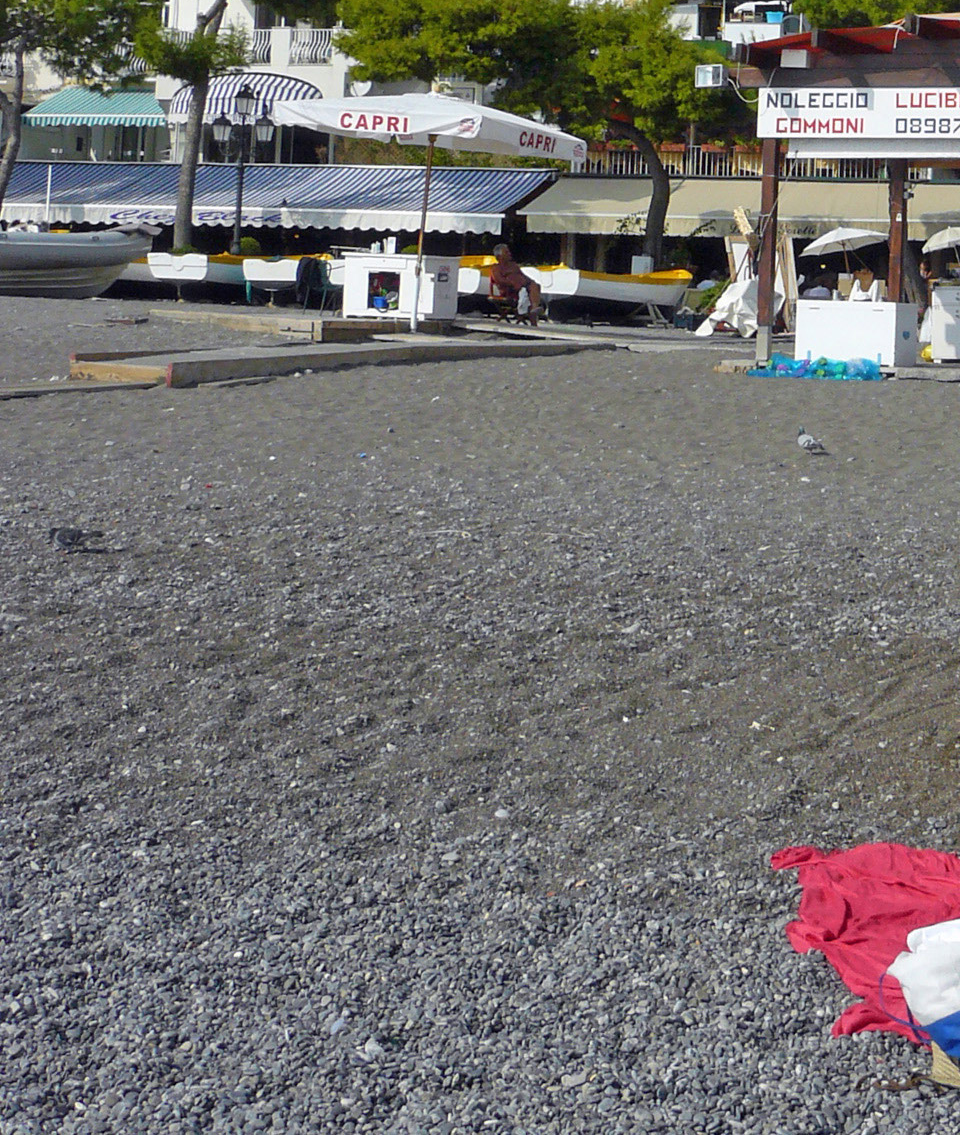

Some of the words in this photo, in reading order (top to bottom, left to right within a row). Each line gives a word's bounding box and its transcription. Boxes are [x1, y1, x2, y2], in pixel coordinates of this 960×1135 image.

[766, 92, 868, 108] NOLEGGIO
[340, 112, 408, 133] CAPRI
[776, 118, 864, 133] GOMMONI
[519, 131, 557, 153] CAPRI
